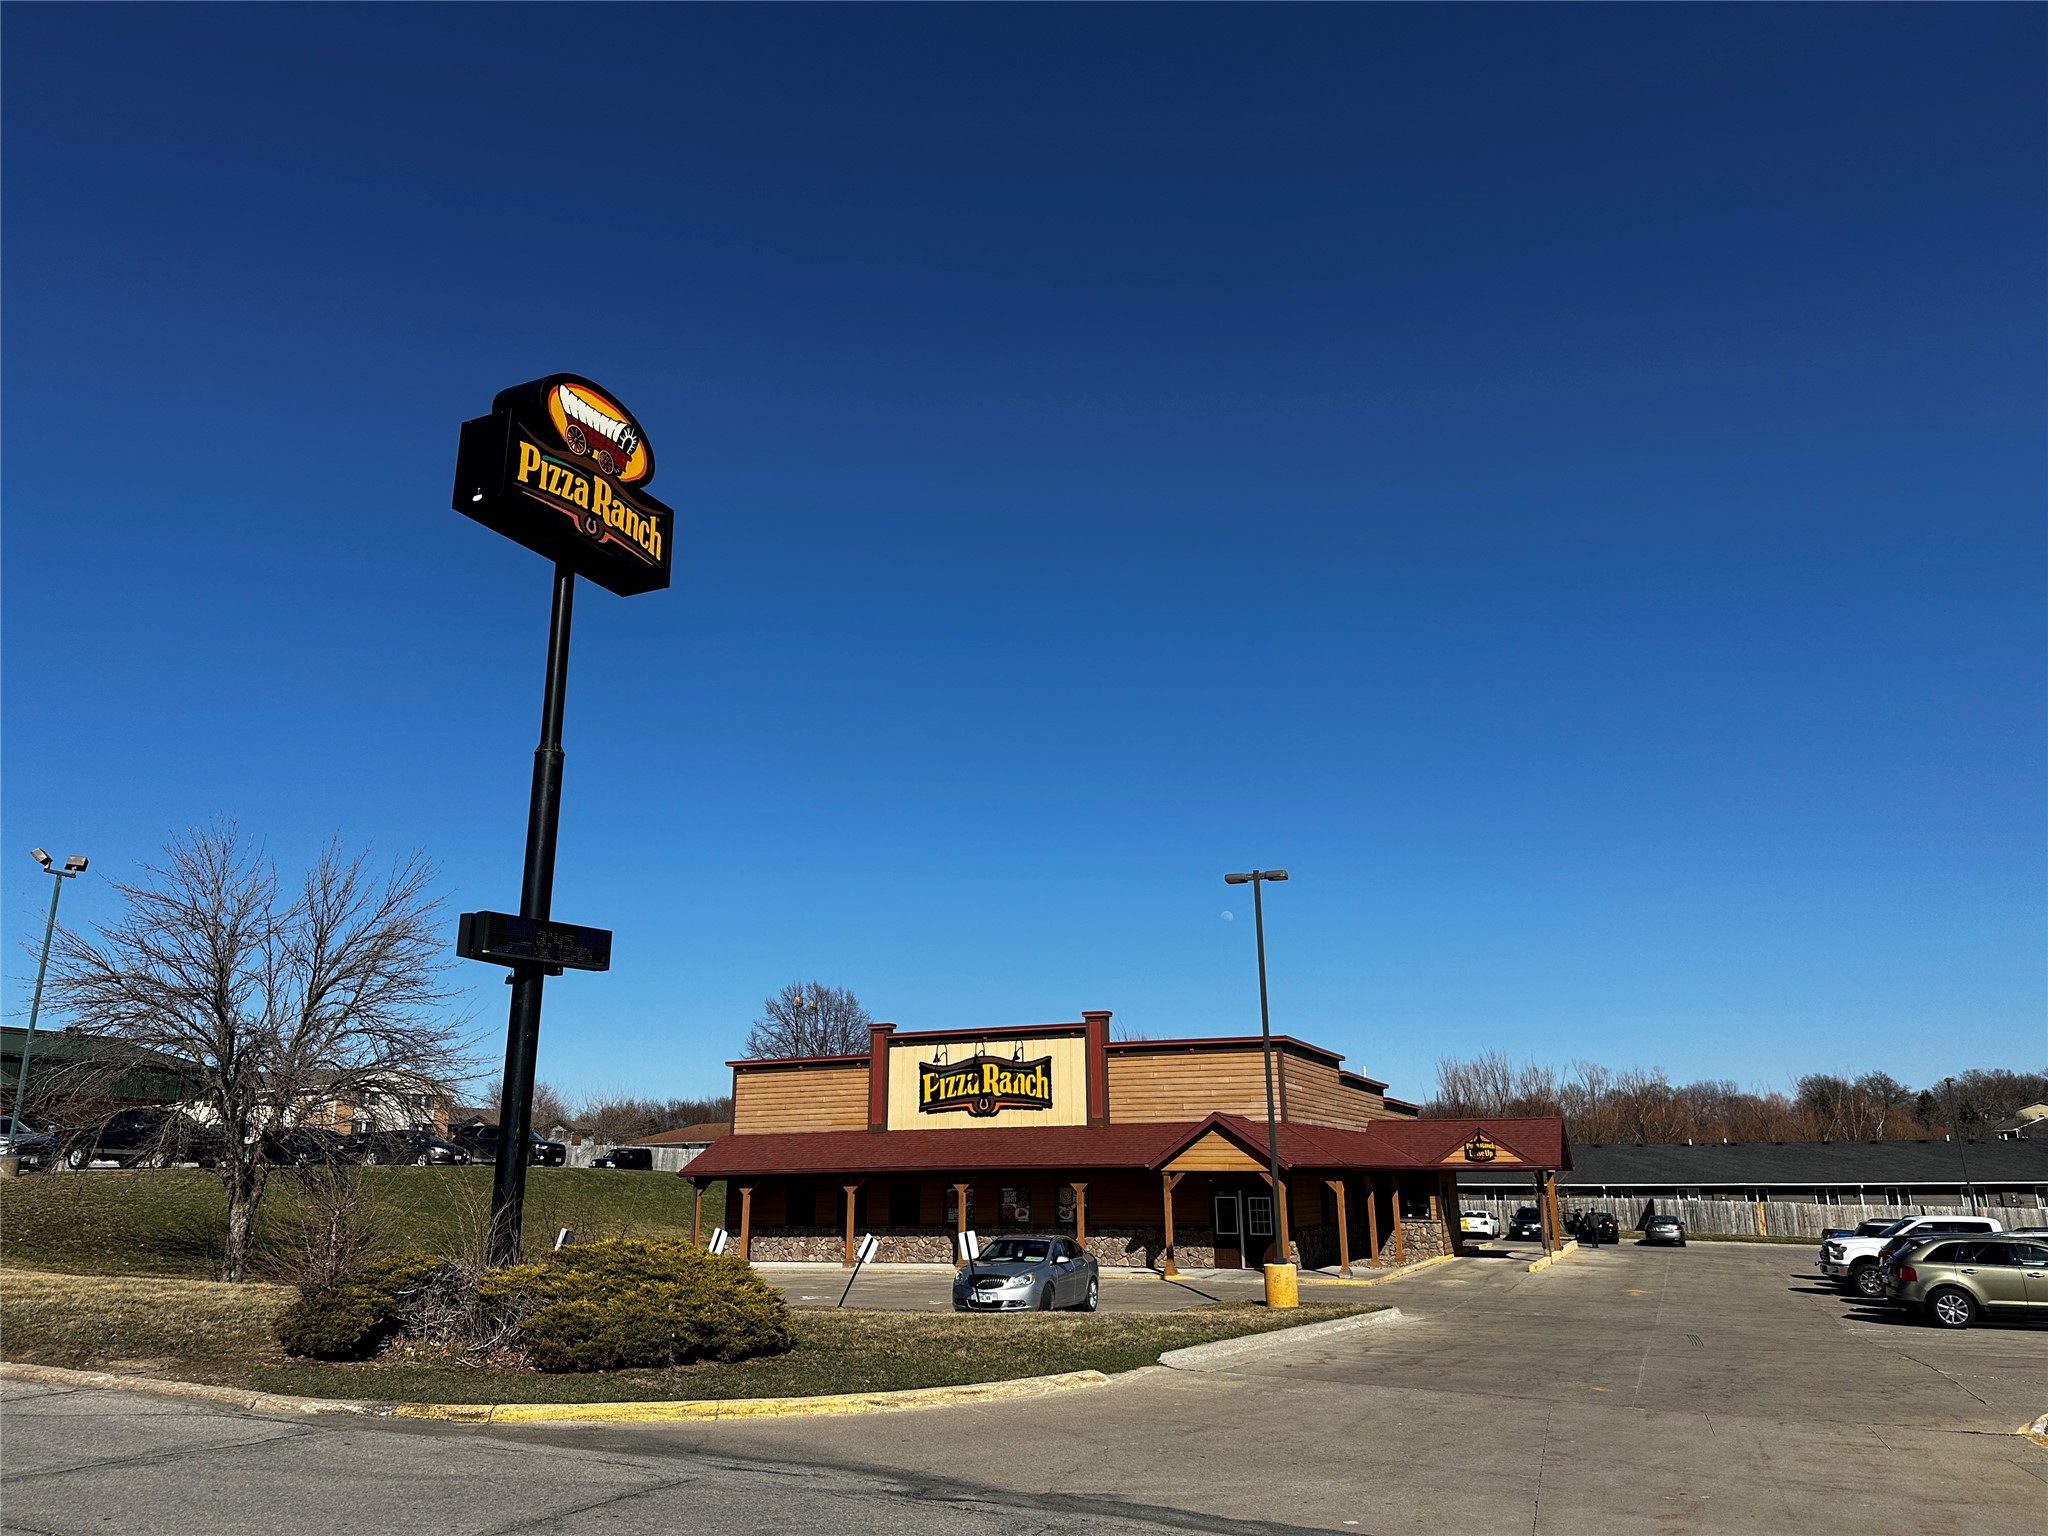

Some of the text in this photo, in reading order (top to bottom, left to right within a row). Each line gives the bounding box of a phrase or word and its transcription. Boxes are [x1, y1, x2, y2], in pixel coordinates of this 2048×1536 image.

[517, 440, 662, 561] Pizza Ranch
[922, 1063, 1049, 1104] Pizza Ranch
